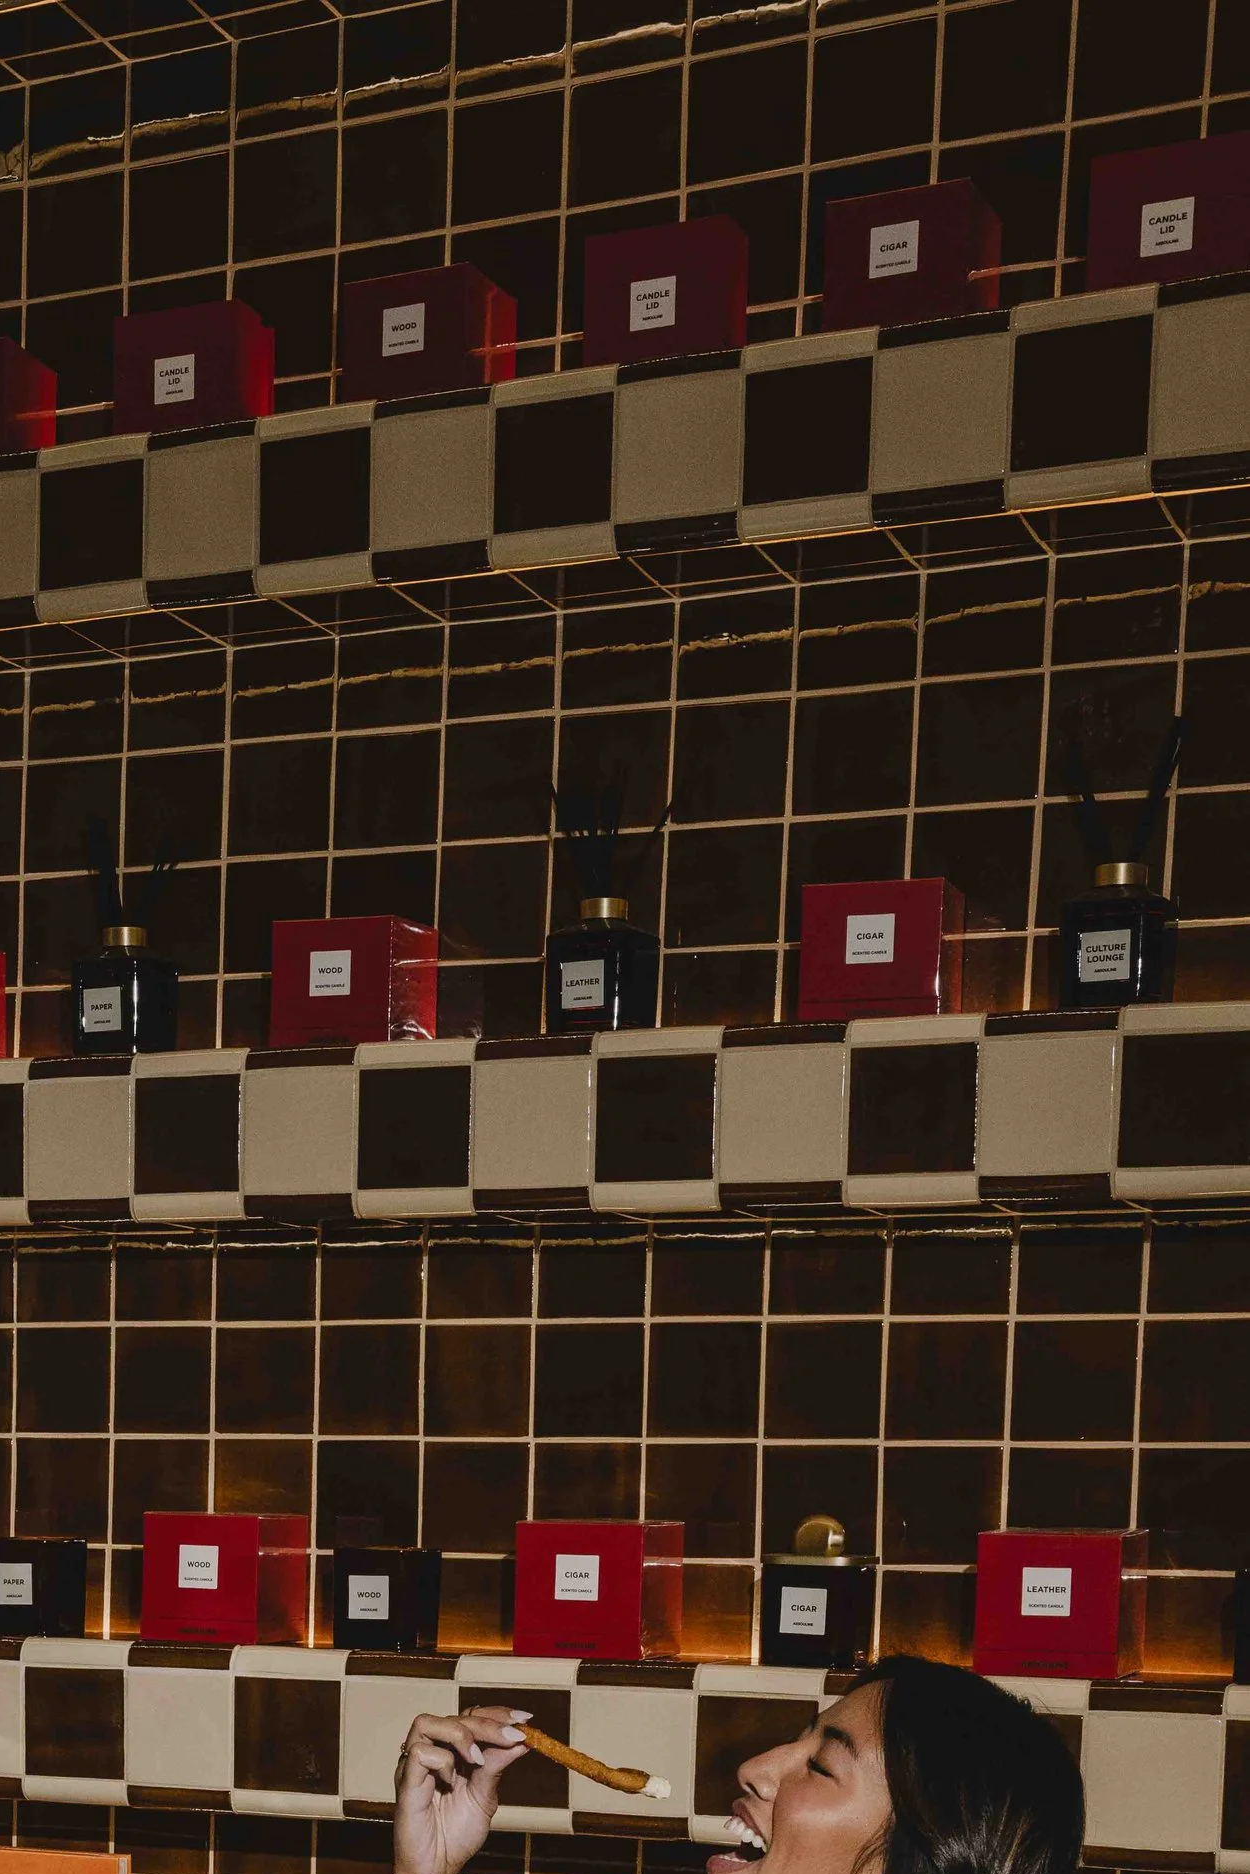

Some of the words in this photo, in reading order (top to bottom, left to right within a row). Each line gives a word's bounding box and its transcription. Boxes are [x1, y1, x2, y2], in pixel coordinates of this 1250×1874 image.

[1148, 212, 1188, 226] CANDLE
[1159, 225, 1175, 235] LID
[880, 241, 908, 253] CIGAR
[636, 290, 670, 302] CANDLE
[646, 302, 659, 310] LID
[391, 322, 417, 332] WOOD
[159, 367, 189, 377] CANDLE
[168, 377, 180, 385] LID
[856, 932, 884, 940] CIGAR
[1085, 942, 1127, 953] CULTURE
[1087, 953, 1124, 963] LOUNGE
[565, 977, 600, 987] LEATHER
[90, 1003, 113, 1011] PAPER
[564, 1571, 590, 1579] CIGAR
[357, 1591, 381, 1599] WOOD
[1027, 1586, 1066, 1594] LEATHER
[791, 1604, 817, 1613] CIGAR
